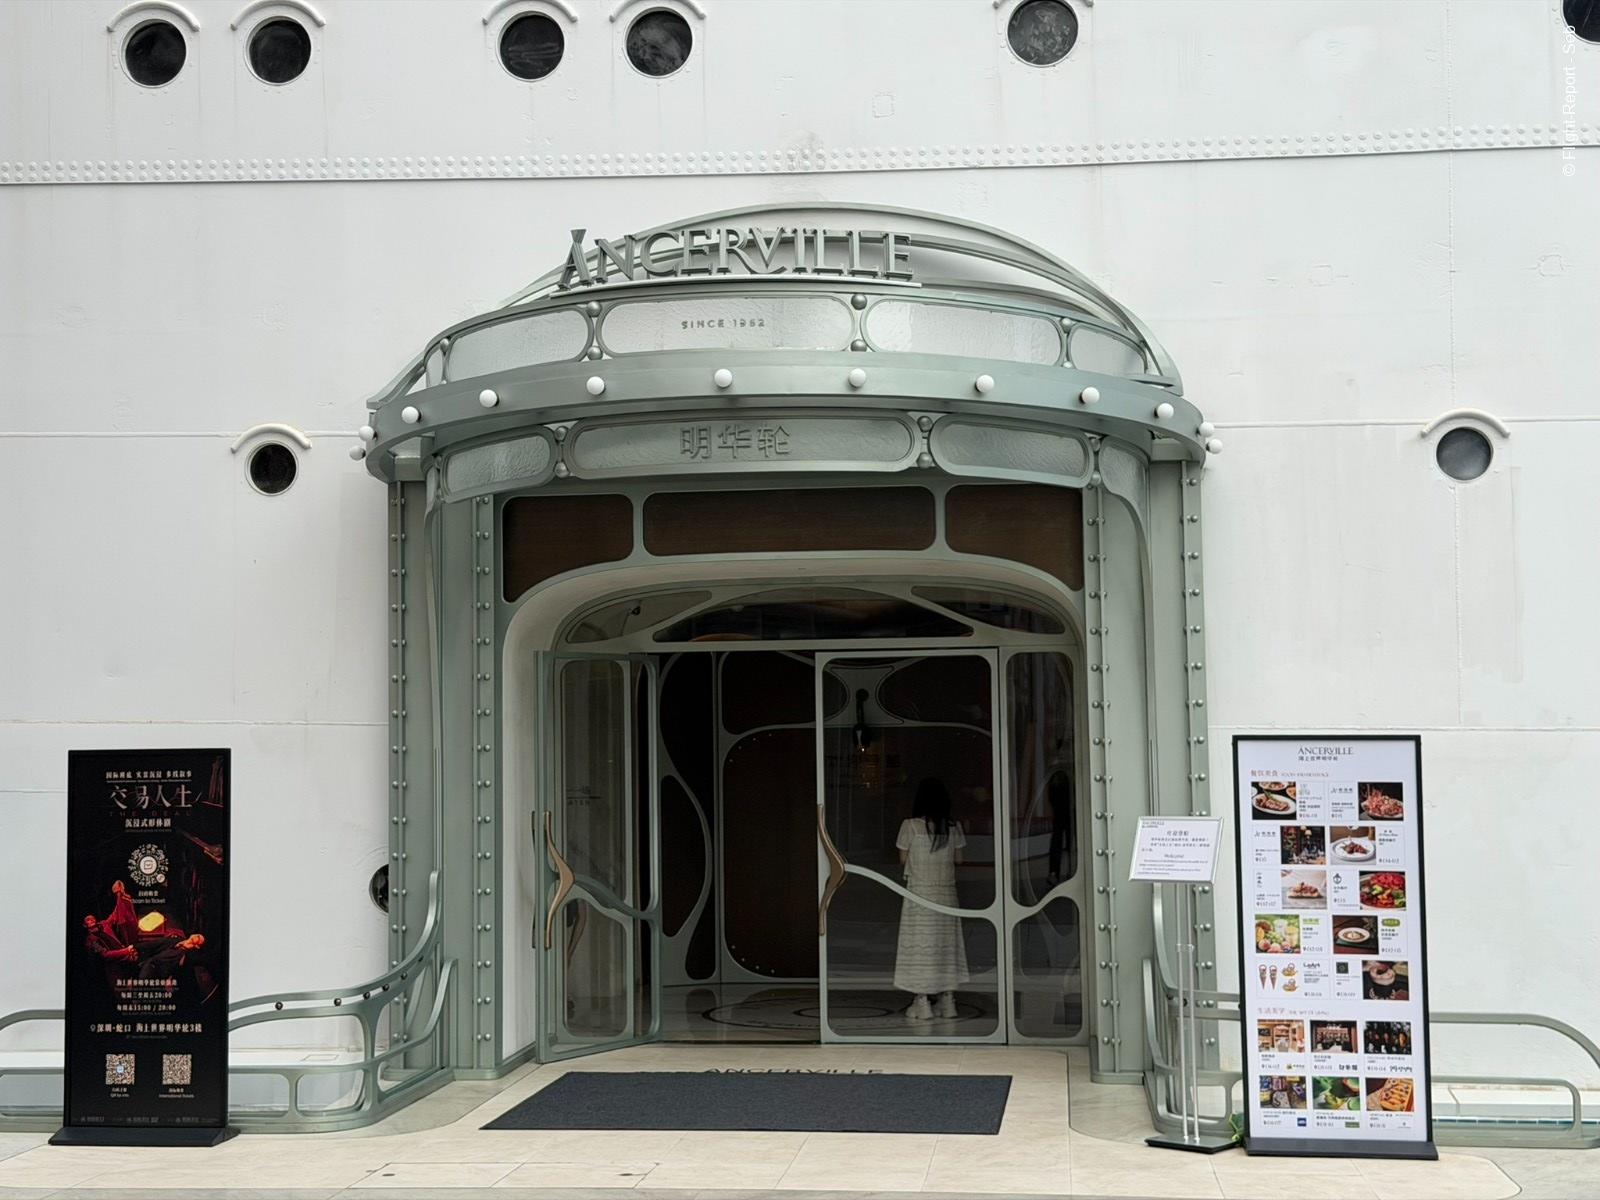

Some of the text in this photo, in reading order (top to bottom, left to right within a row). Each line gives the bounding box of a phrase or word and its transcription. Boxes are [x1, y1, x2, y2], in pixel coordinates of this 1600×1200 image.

[558, 227, 914, 292] ANCERVILLE
[681, 319, 725, 330] SINCE
[679, 424, 791, 460] 明华轮
[1298, 746, 1354, 755] ANCERVILLE
[110, 784, 193, 810] 交易人生
